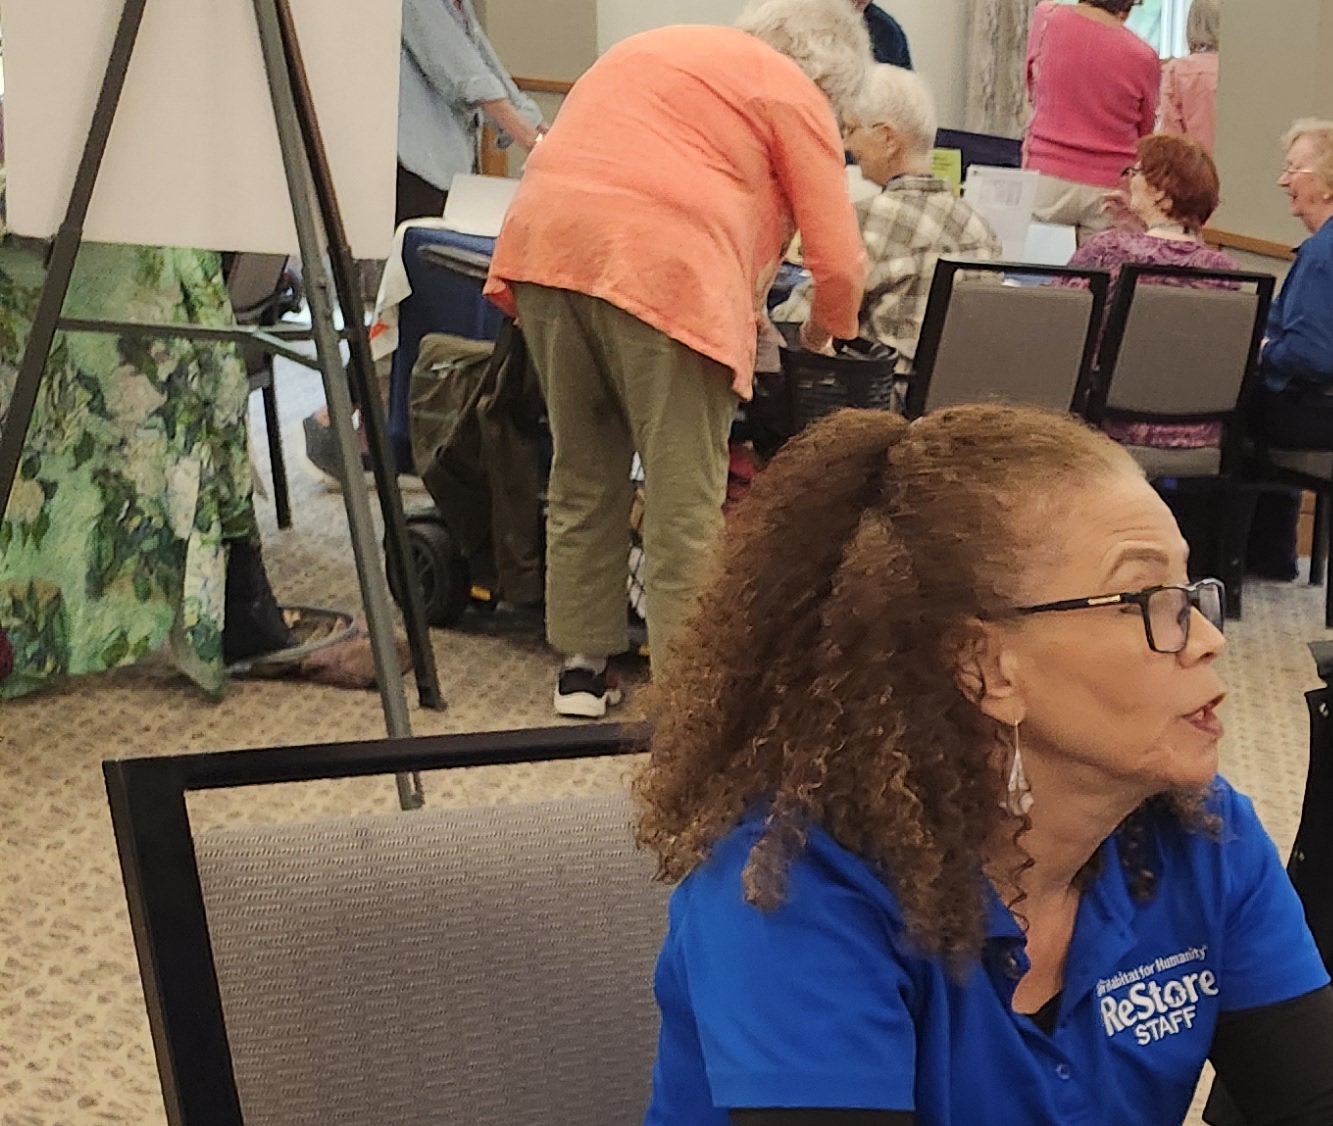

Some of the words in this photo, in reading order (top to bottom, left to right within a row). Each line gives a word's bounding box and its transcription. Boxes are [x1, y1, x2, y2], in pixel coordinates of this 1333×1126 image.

[1105, 969, 1140, 992] Habitat
[1140, 963, 1155, 979] for
[1101, 970, 1219, 1036] ReStore
[1135, 1005, 1196, 1045] STAFF
